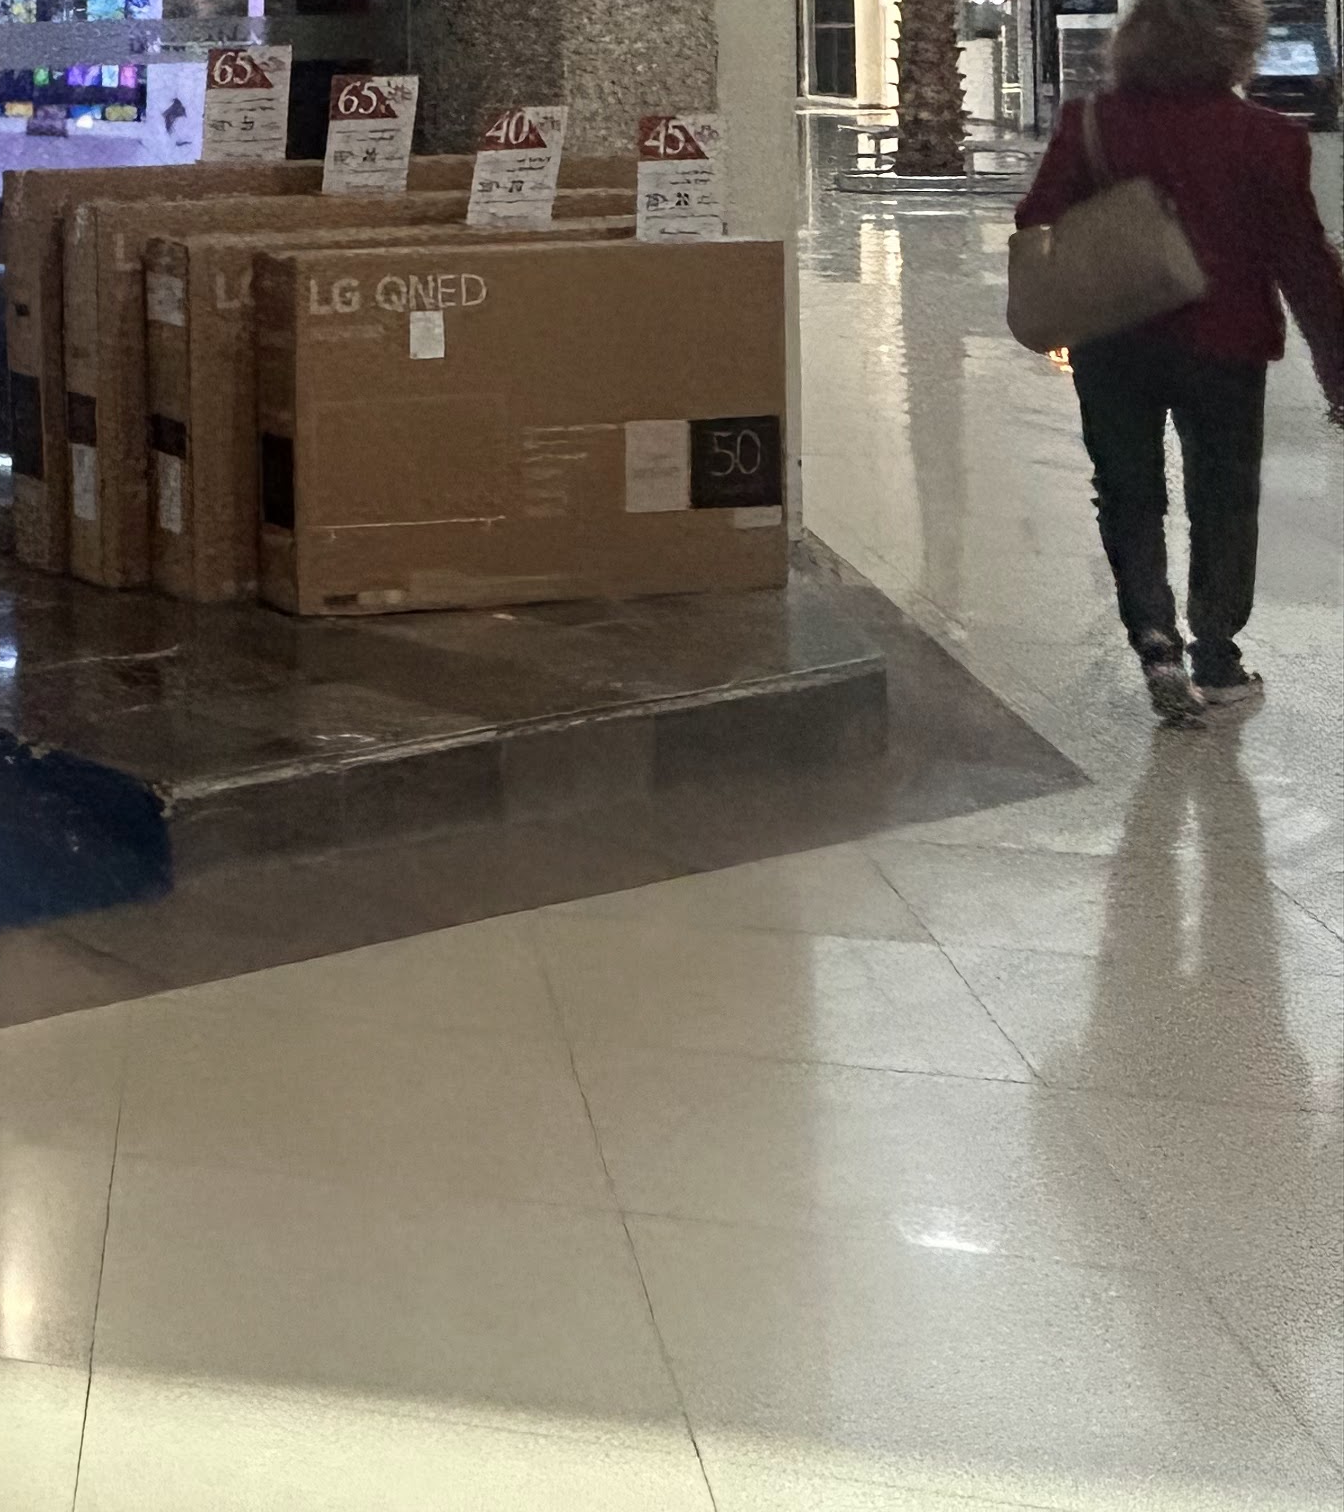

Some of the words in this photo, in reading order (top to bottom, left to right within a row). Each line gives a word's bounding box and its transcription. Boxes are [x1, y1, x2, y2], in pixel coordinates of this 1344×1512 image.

[213, 51, 253, 85] 65
[337, 81, 378, 115] 65
[484, 110, 530, 145] 40
[643, 119, 686, 158] 45
[309, 276, 361, 315] LG
[375, 272, 489, 313] QNED
[708, 429, 762, 477] 50
